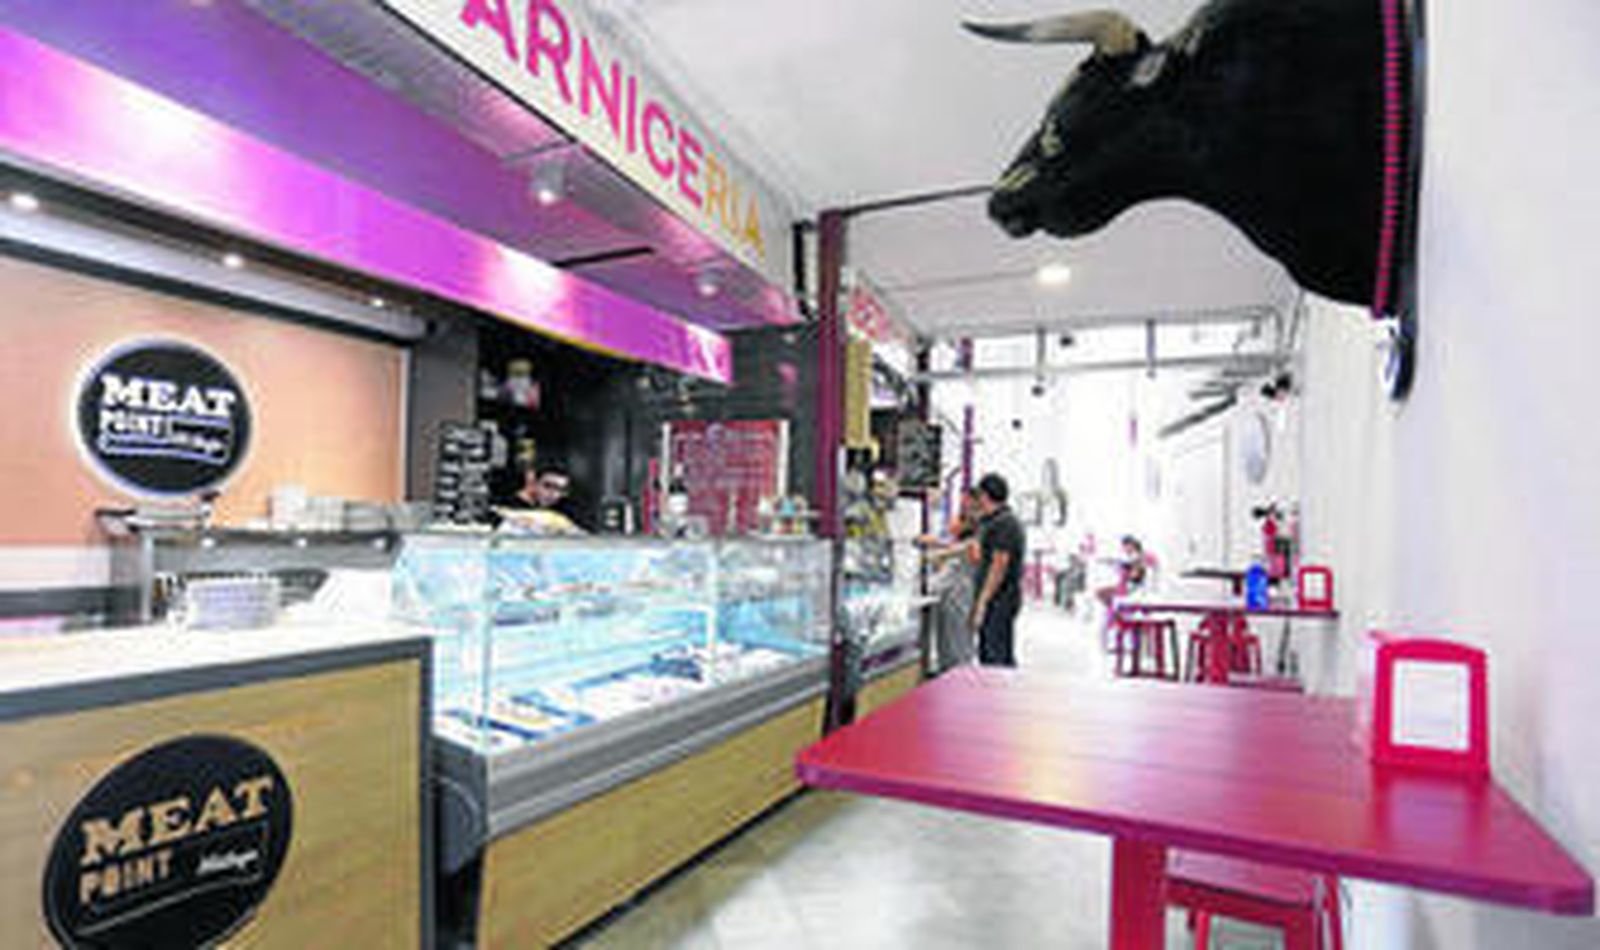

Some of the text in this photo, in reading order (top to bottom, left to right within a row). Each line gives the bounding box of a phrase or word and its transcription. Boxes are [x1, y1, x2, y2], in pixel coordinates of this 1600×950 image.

[101, 375, 236, 416] MEAT
[100, 410, 162, 436] POINT
[80, 776, 274, 866] MEAT
[79, 849, 173, 904] POINT
